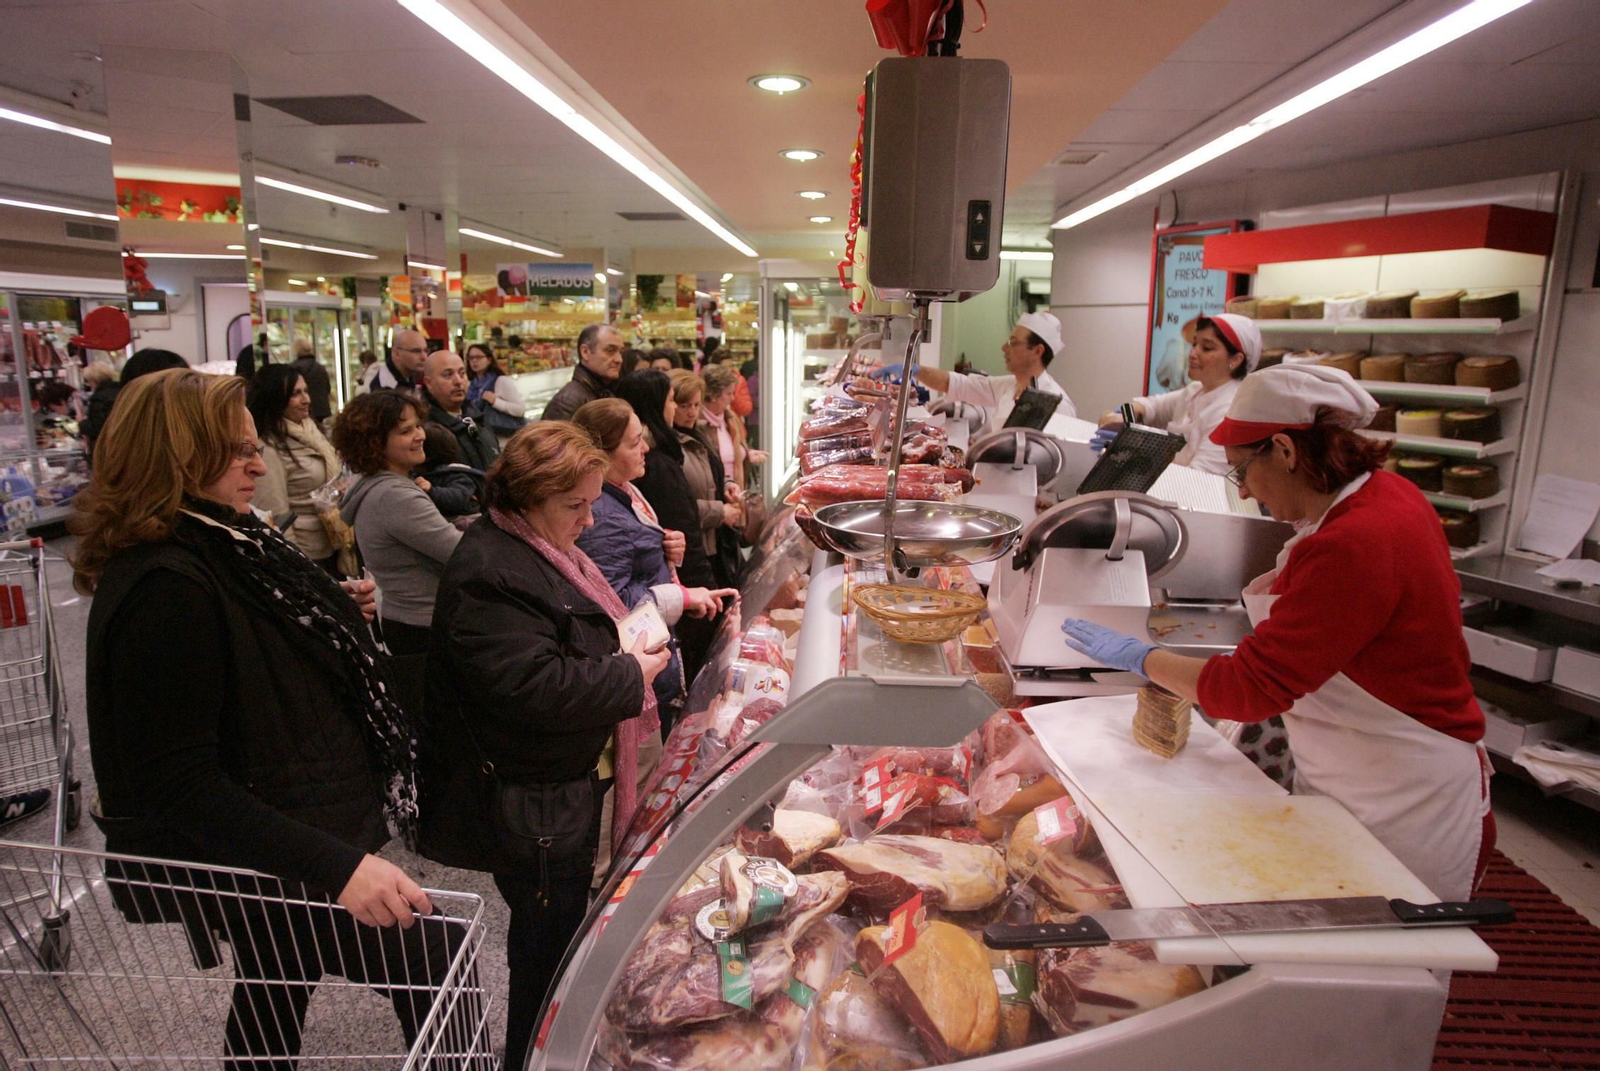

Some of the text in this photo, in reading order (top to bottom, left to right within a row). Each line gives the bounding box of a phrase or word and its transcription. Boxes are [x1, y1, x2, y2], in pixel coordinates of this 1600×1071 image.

[1175, 268, 1209, 280] FRESCO
[530, 274, 591, 288] HELADOS
[1166, 286, 1190, 298] Canal
[1191, 286, 1205, 298] 5-7
[1167, 312, 1179, 324] Kg
[5, 802, 25, 818] N
